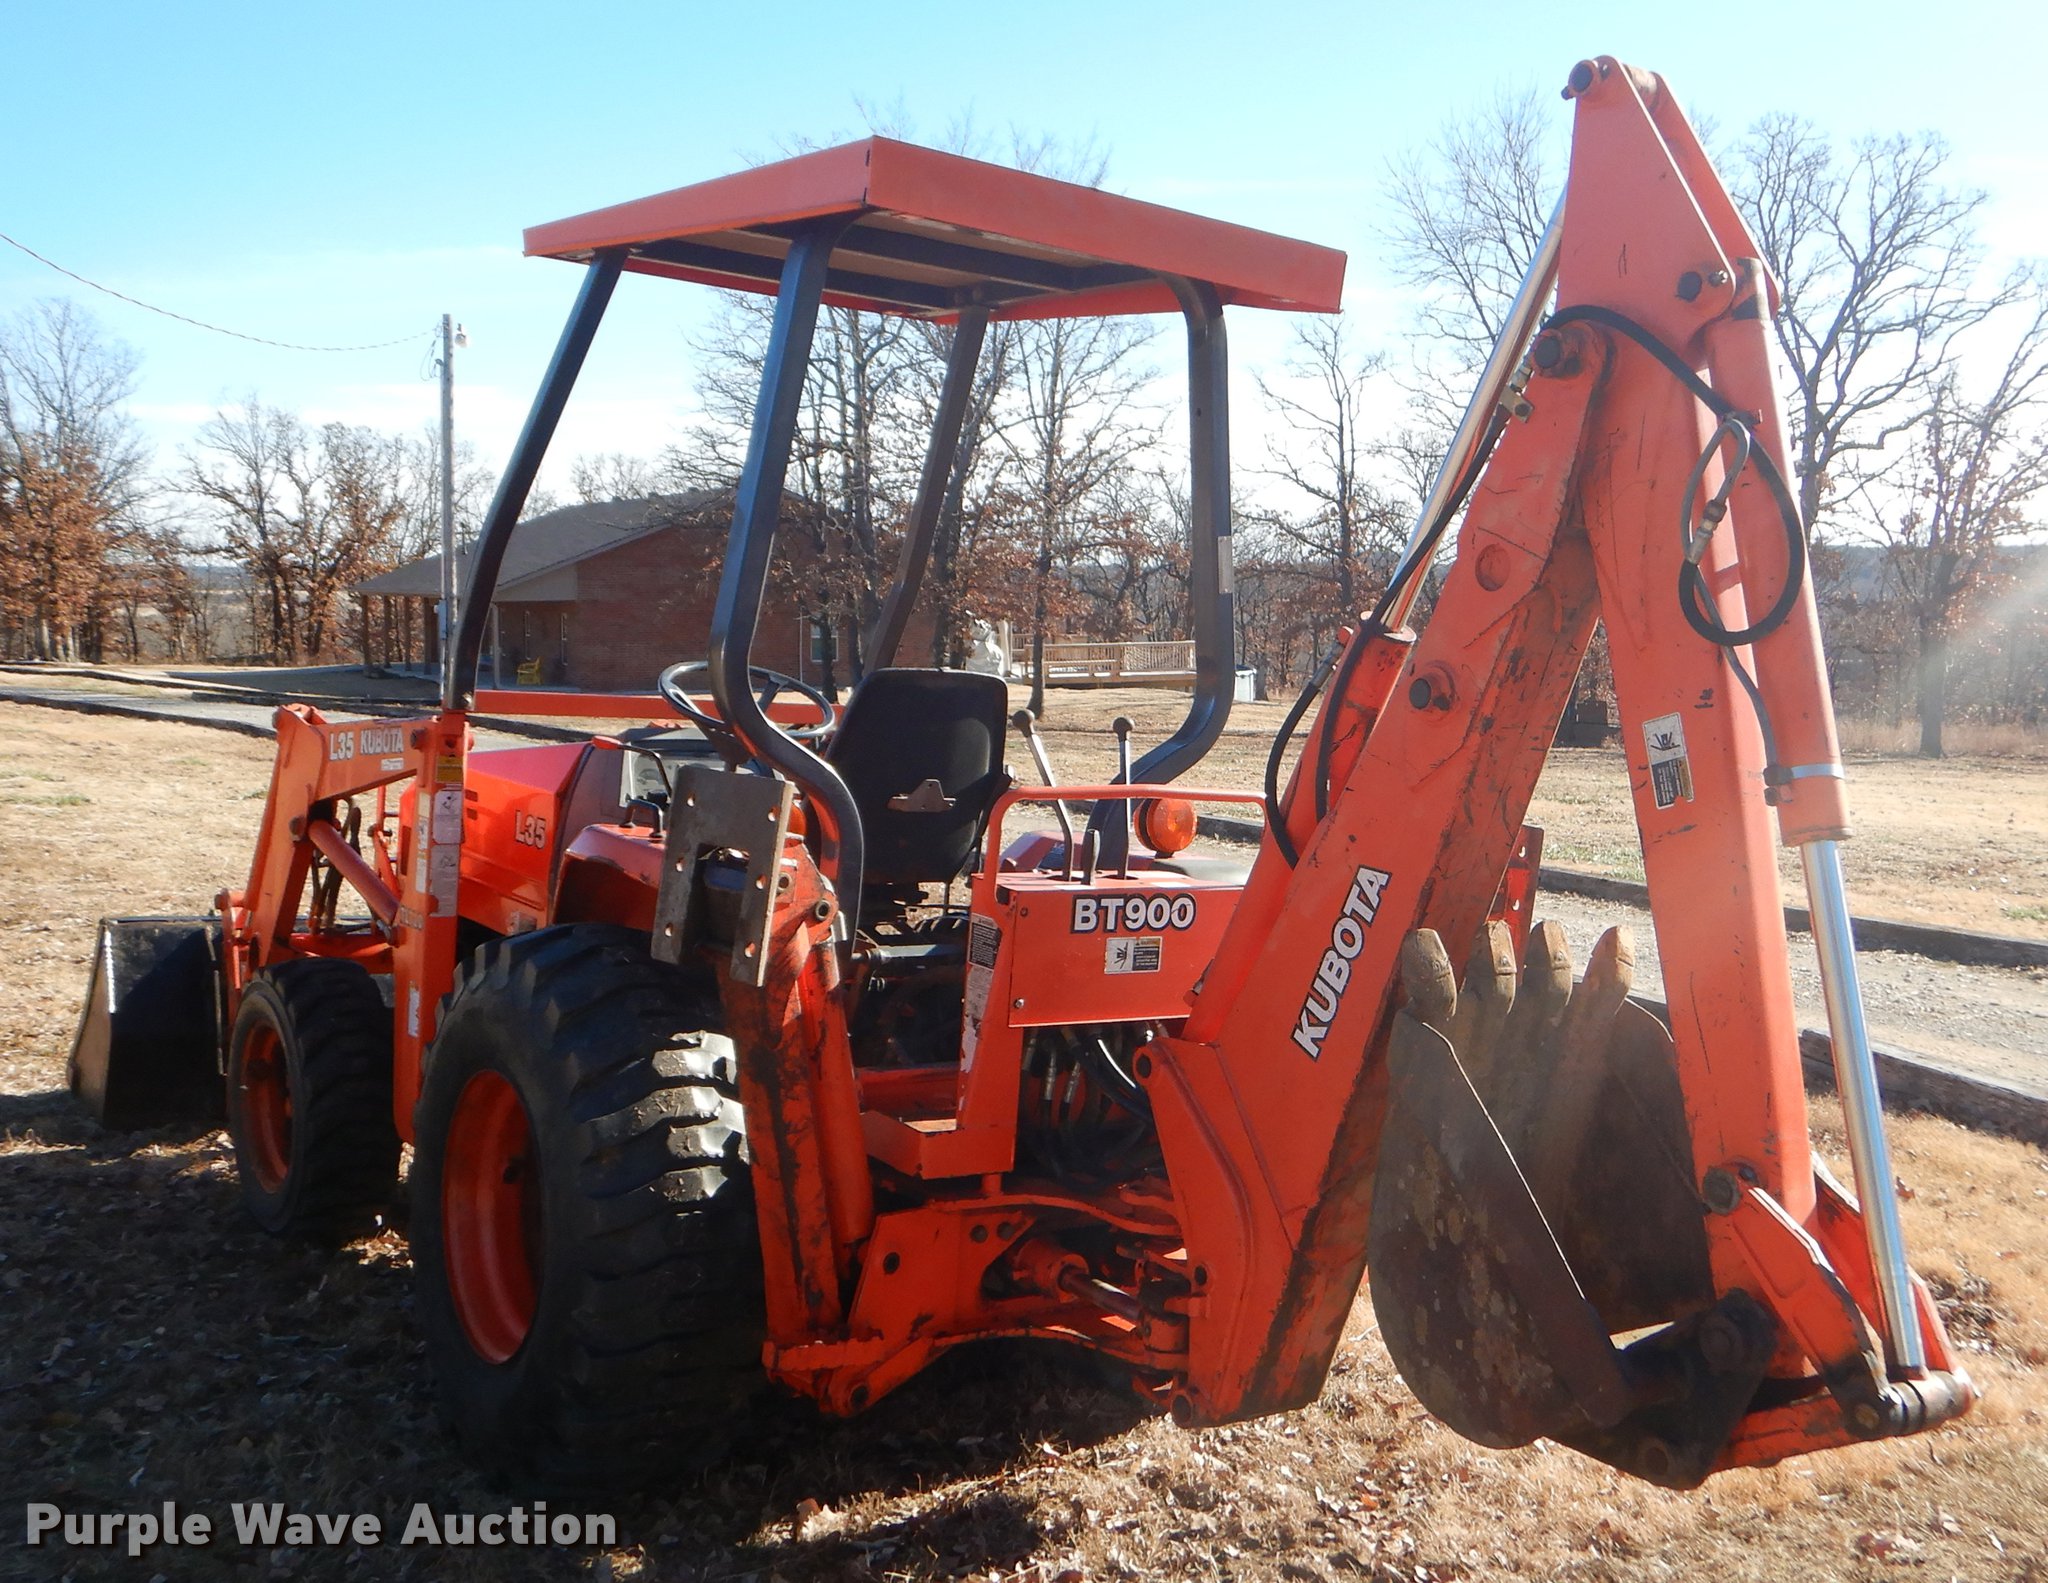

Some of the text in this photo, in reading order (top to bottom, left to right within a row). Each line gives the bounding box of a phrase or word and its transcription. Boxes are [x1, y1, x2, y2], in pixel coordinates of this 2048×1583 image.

[330, 728, 404, 761] L35 KUBOTA
[515, 810, 546, 849] L35
[1071, 894, 1196, 933] BT900
[1291, 866, 1391, 1060] KUBOTA
